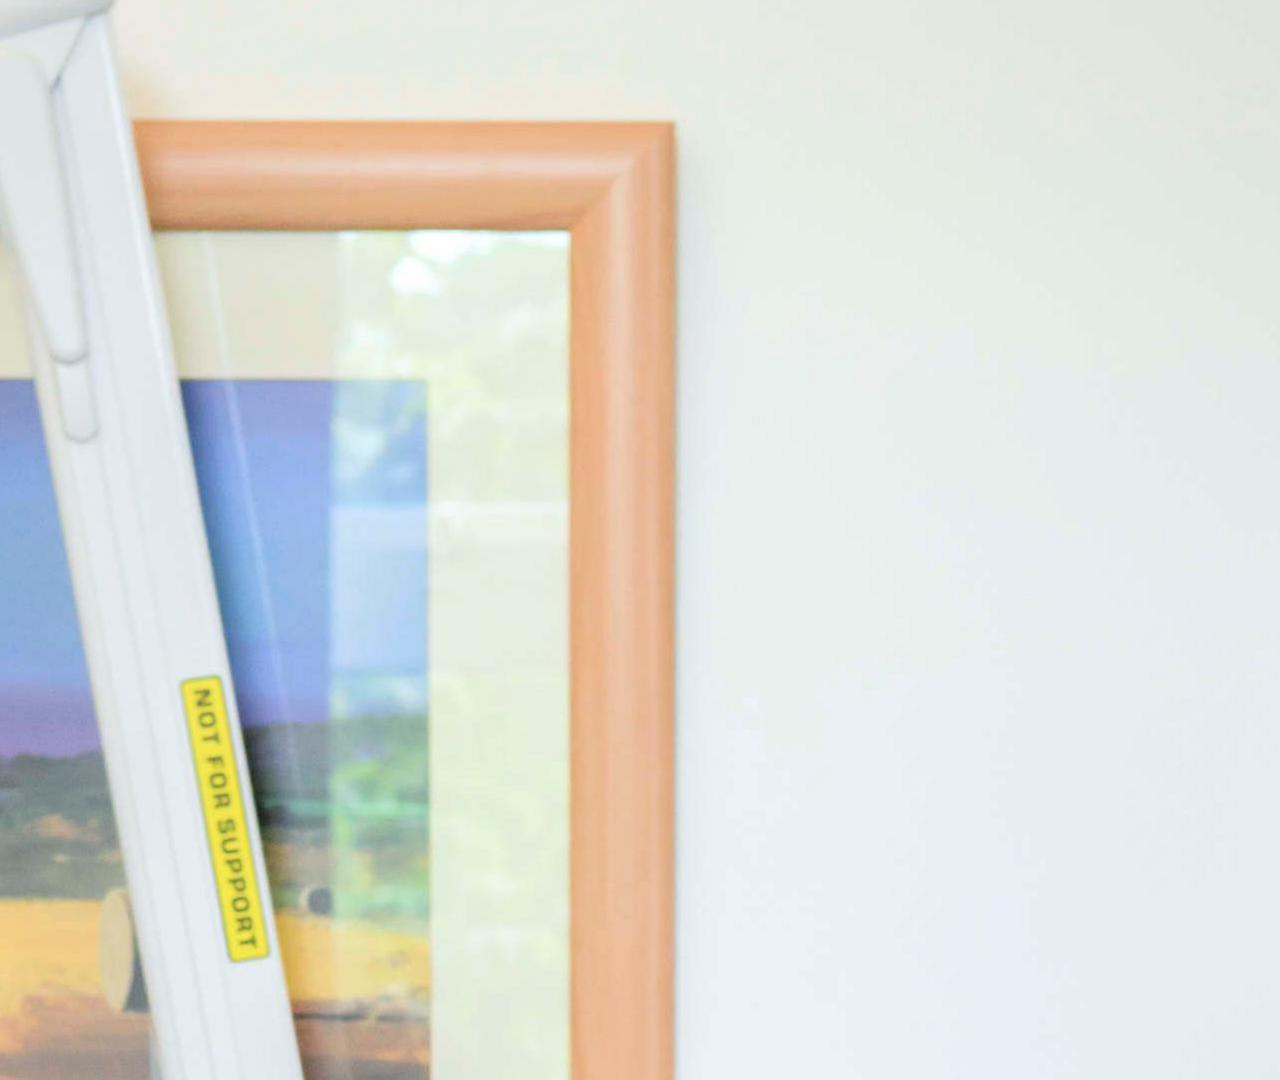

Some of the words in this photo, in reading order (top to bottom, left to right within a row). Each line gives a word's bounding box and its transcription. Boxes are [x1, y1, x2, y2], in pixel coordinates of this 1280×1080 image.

[194, 688, 220, 744] NOT
[207, 755, 232, 810] FOR
[217, 817, 257, 949] SUPPORT
